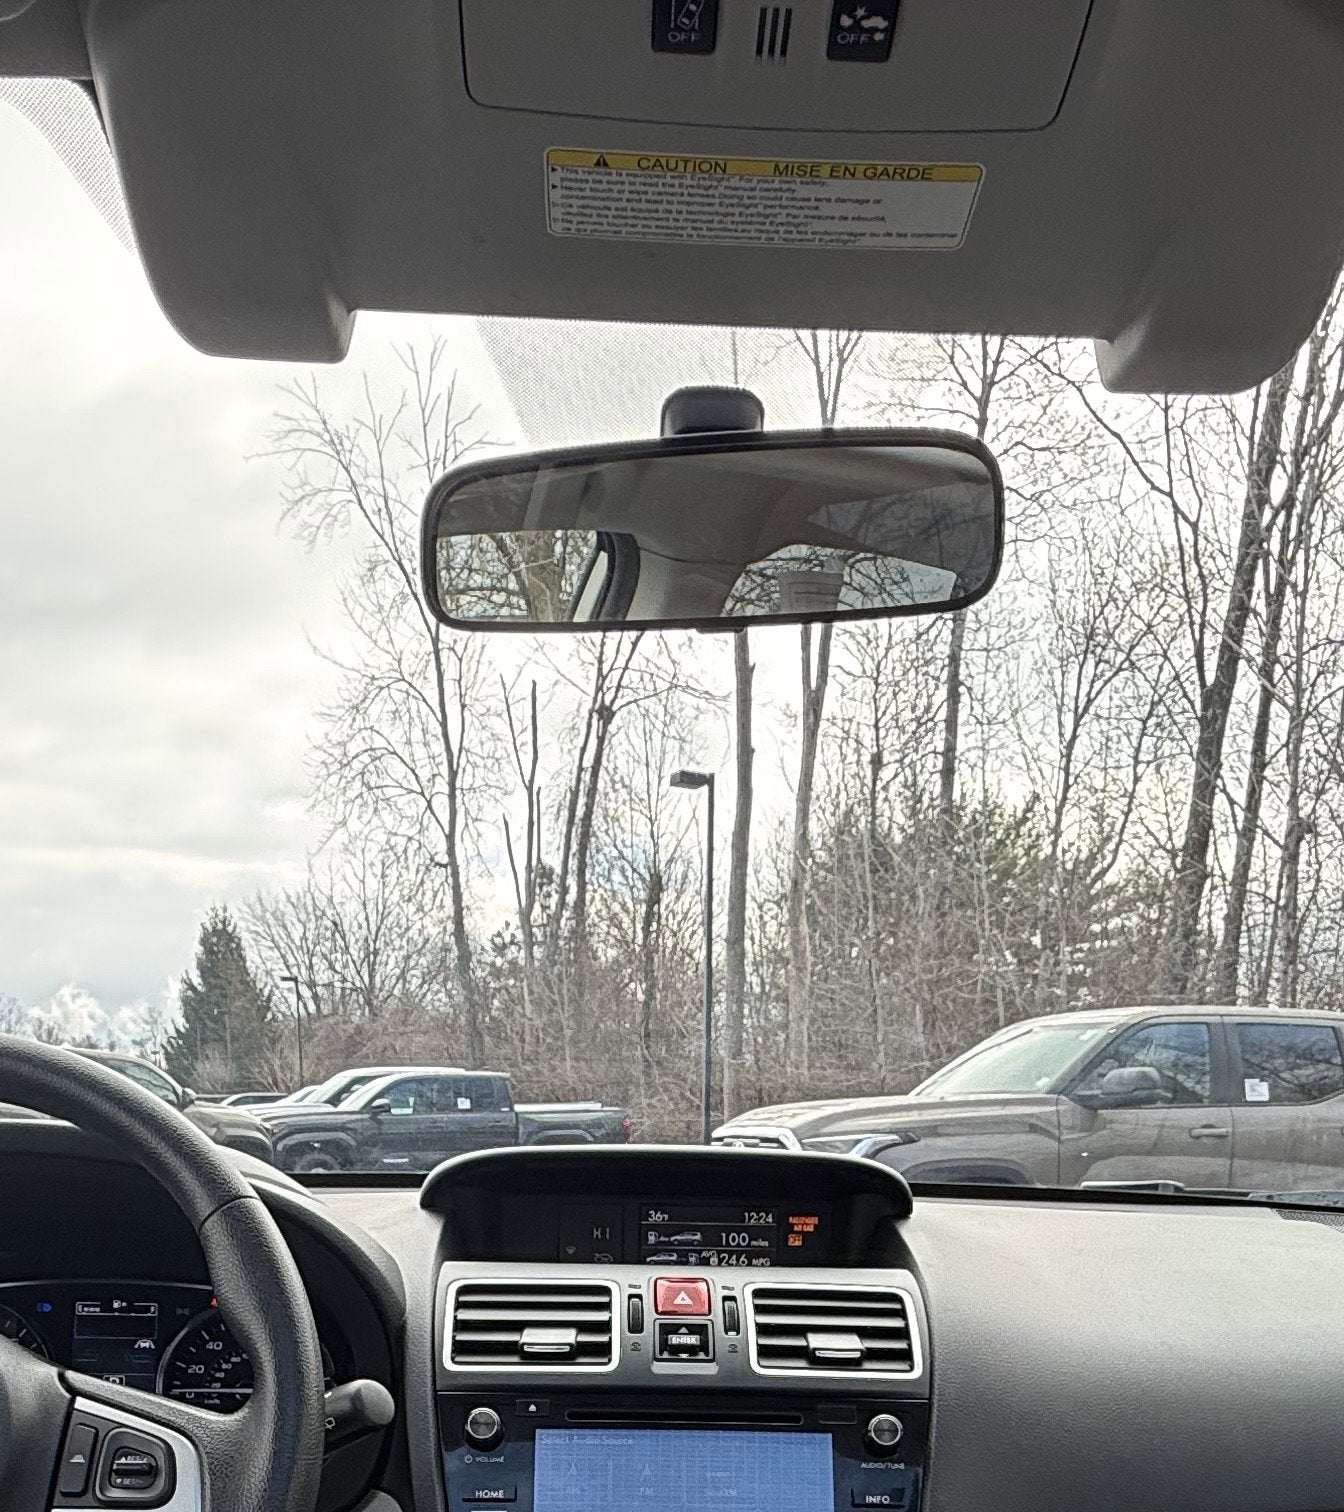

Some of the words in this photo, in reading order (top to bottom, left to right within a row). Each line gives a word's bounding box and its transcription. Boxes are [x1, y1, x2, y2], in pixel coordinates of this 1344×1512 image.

[668, 30, 700, 43] OFF
[836, 31, 870, 45] OFF
[637, 156, 728, 175] CAUTION
[772, 164, 821, 179] MISE
[829, 165, 857, 179] EN
[862, 166, 934, 181] GARDE
[744, 1211, 774, 1224] 12:24
[720, 1232, 749, 1247] 100
[205, 1341, 223, 1351] 40
[187, 1364, 205, 1374] 20
[475, 1489, 505, 1499] HOME
[865, 1495, 890, 1505] INFO
